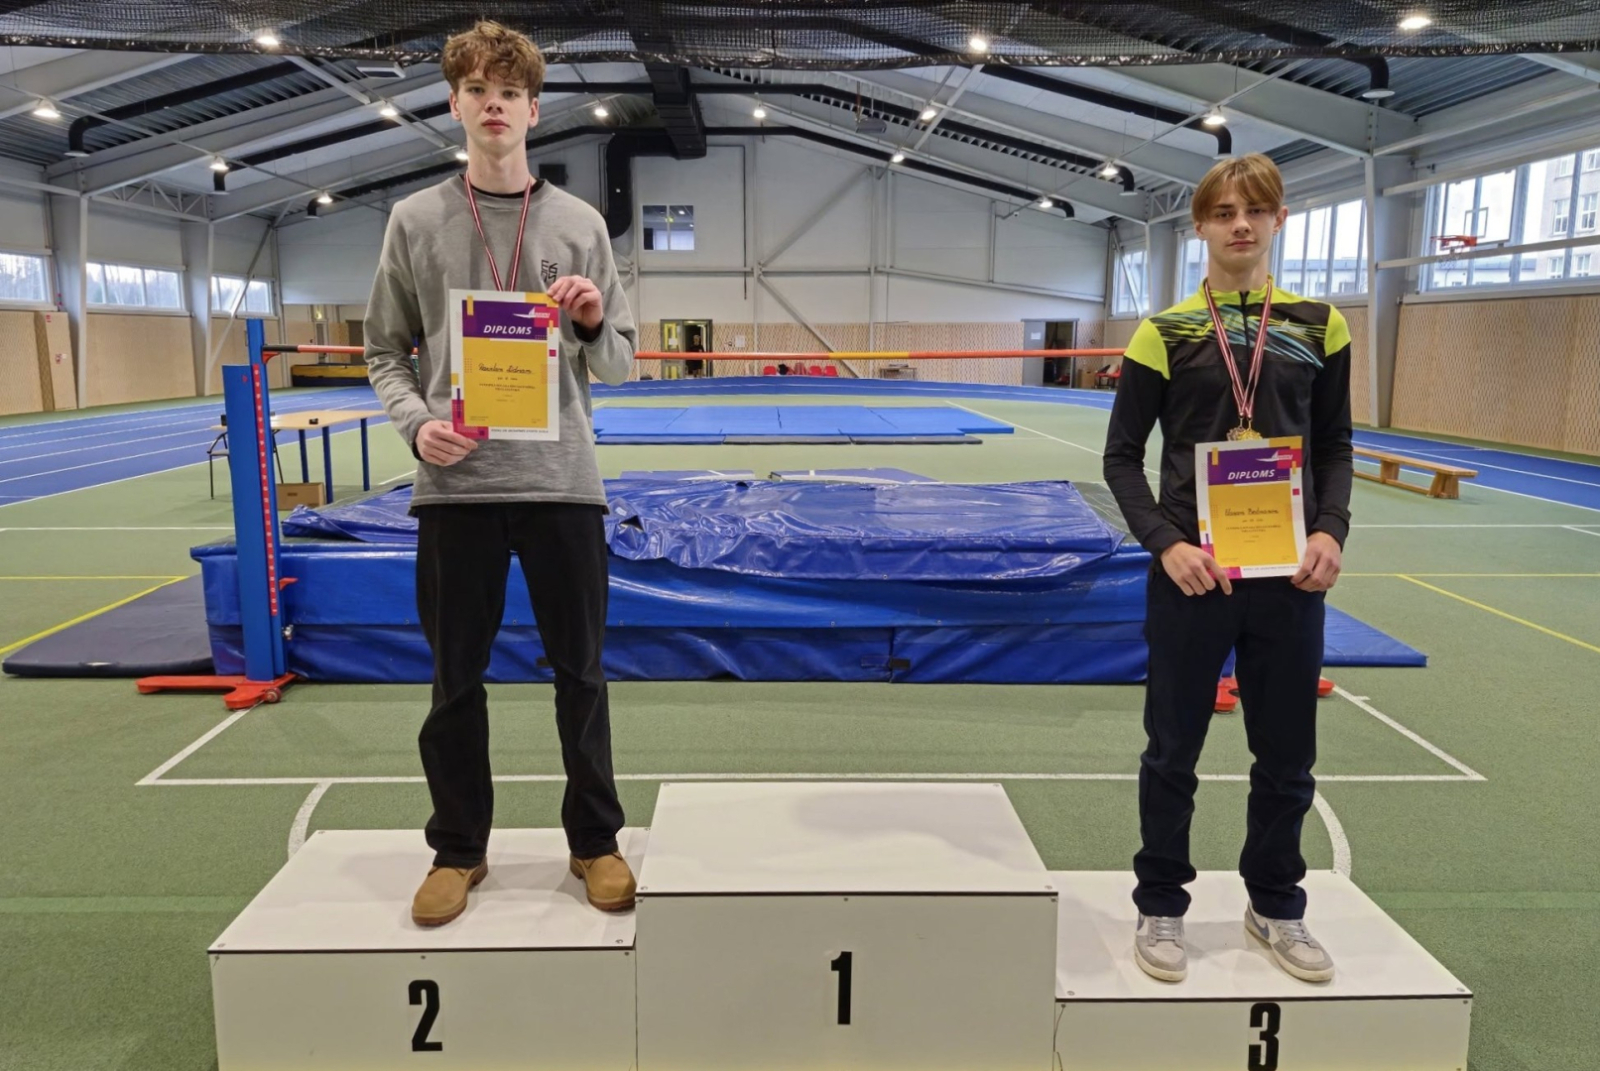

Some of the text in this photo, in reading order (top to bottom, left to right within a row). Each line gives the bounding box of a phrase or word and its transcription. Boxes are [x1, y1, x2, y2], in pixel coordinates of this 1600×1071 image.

[483, 324, 532, 335] DIPLOMS
[1227, 469, 1276, 480] DIPLOMS
[408, 979, 443, 1052] 2
[831, 951, 852, 1025] 1
[1248, 1002, 1281, 1071] 3
